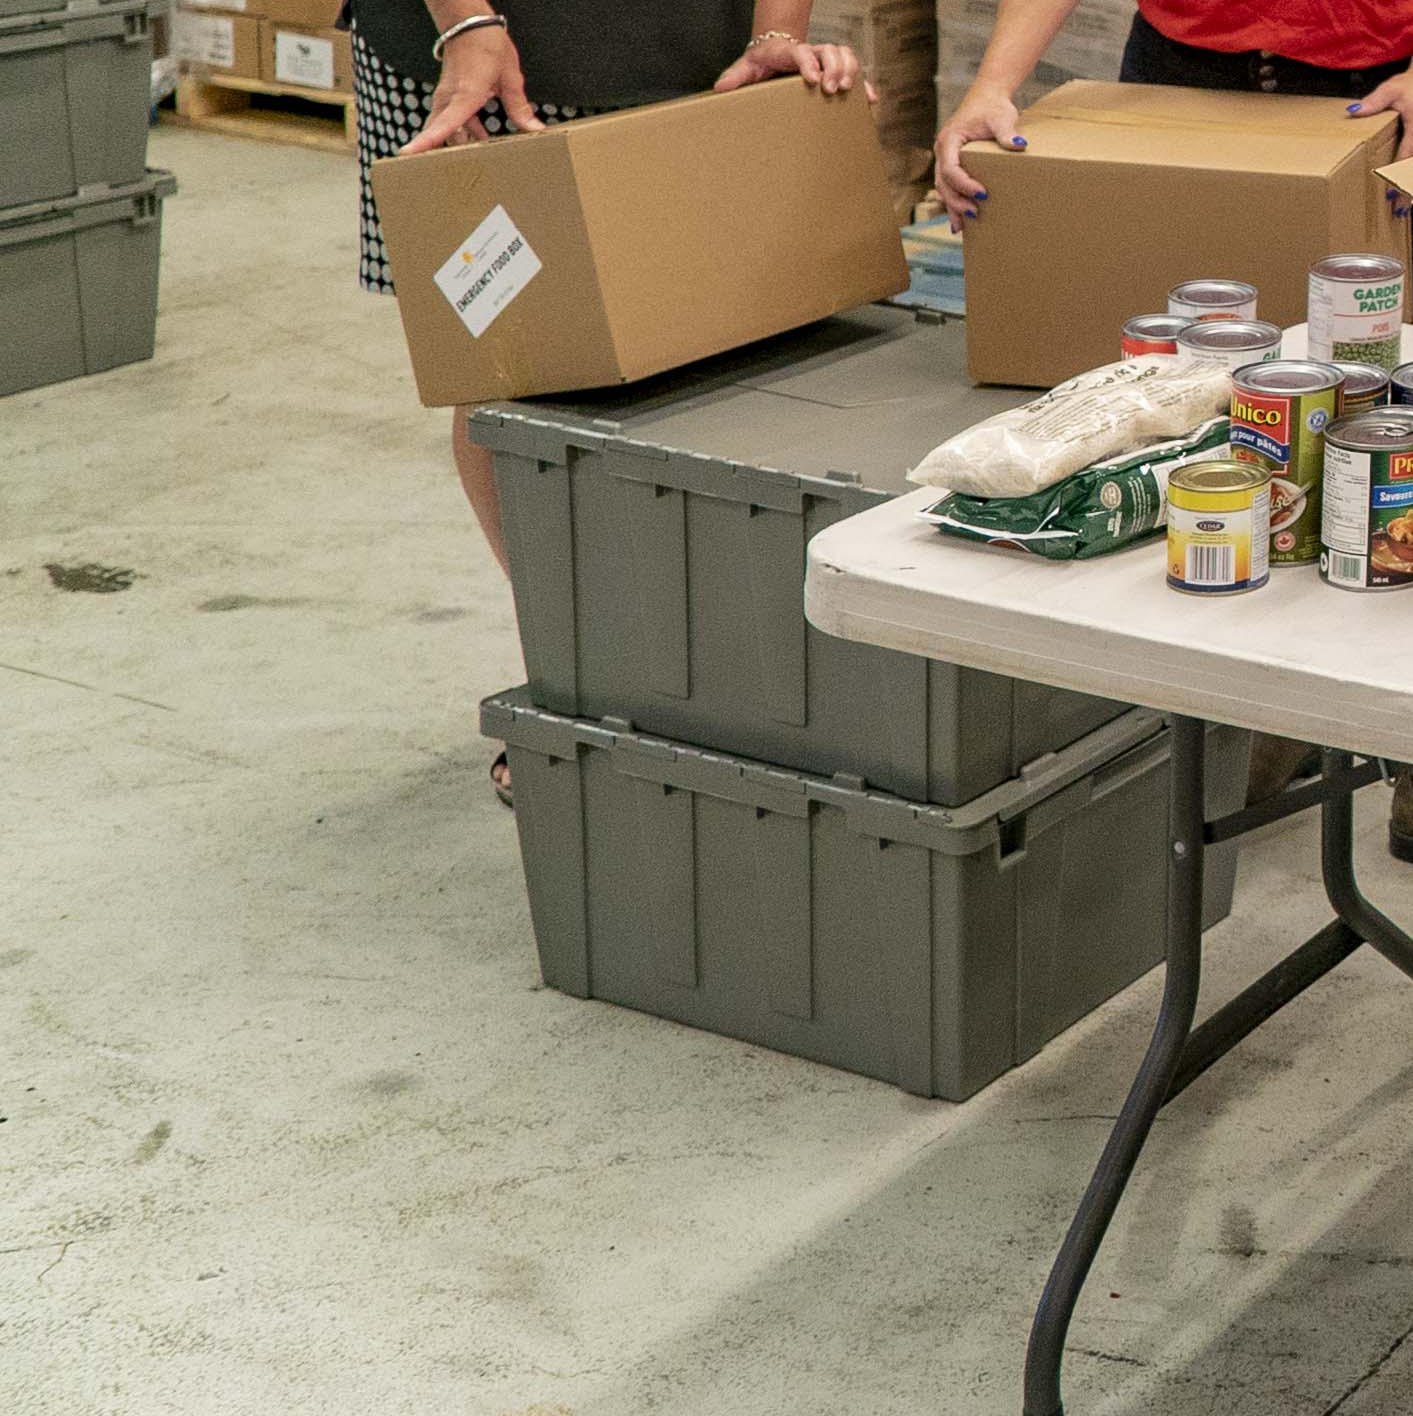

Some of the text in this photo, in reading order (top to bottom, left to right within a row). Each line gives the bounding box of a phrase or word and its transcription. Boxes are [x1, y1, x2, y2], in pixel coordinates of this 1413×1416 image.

[455, 236, 524, 313] EMERGENCY FOOD BOX
[1231, 395, 1282, 425] Unico
